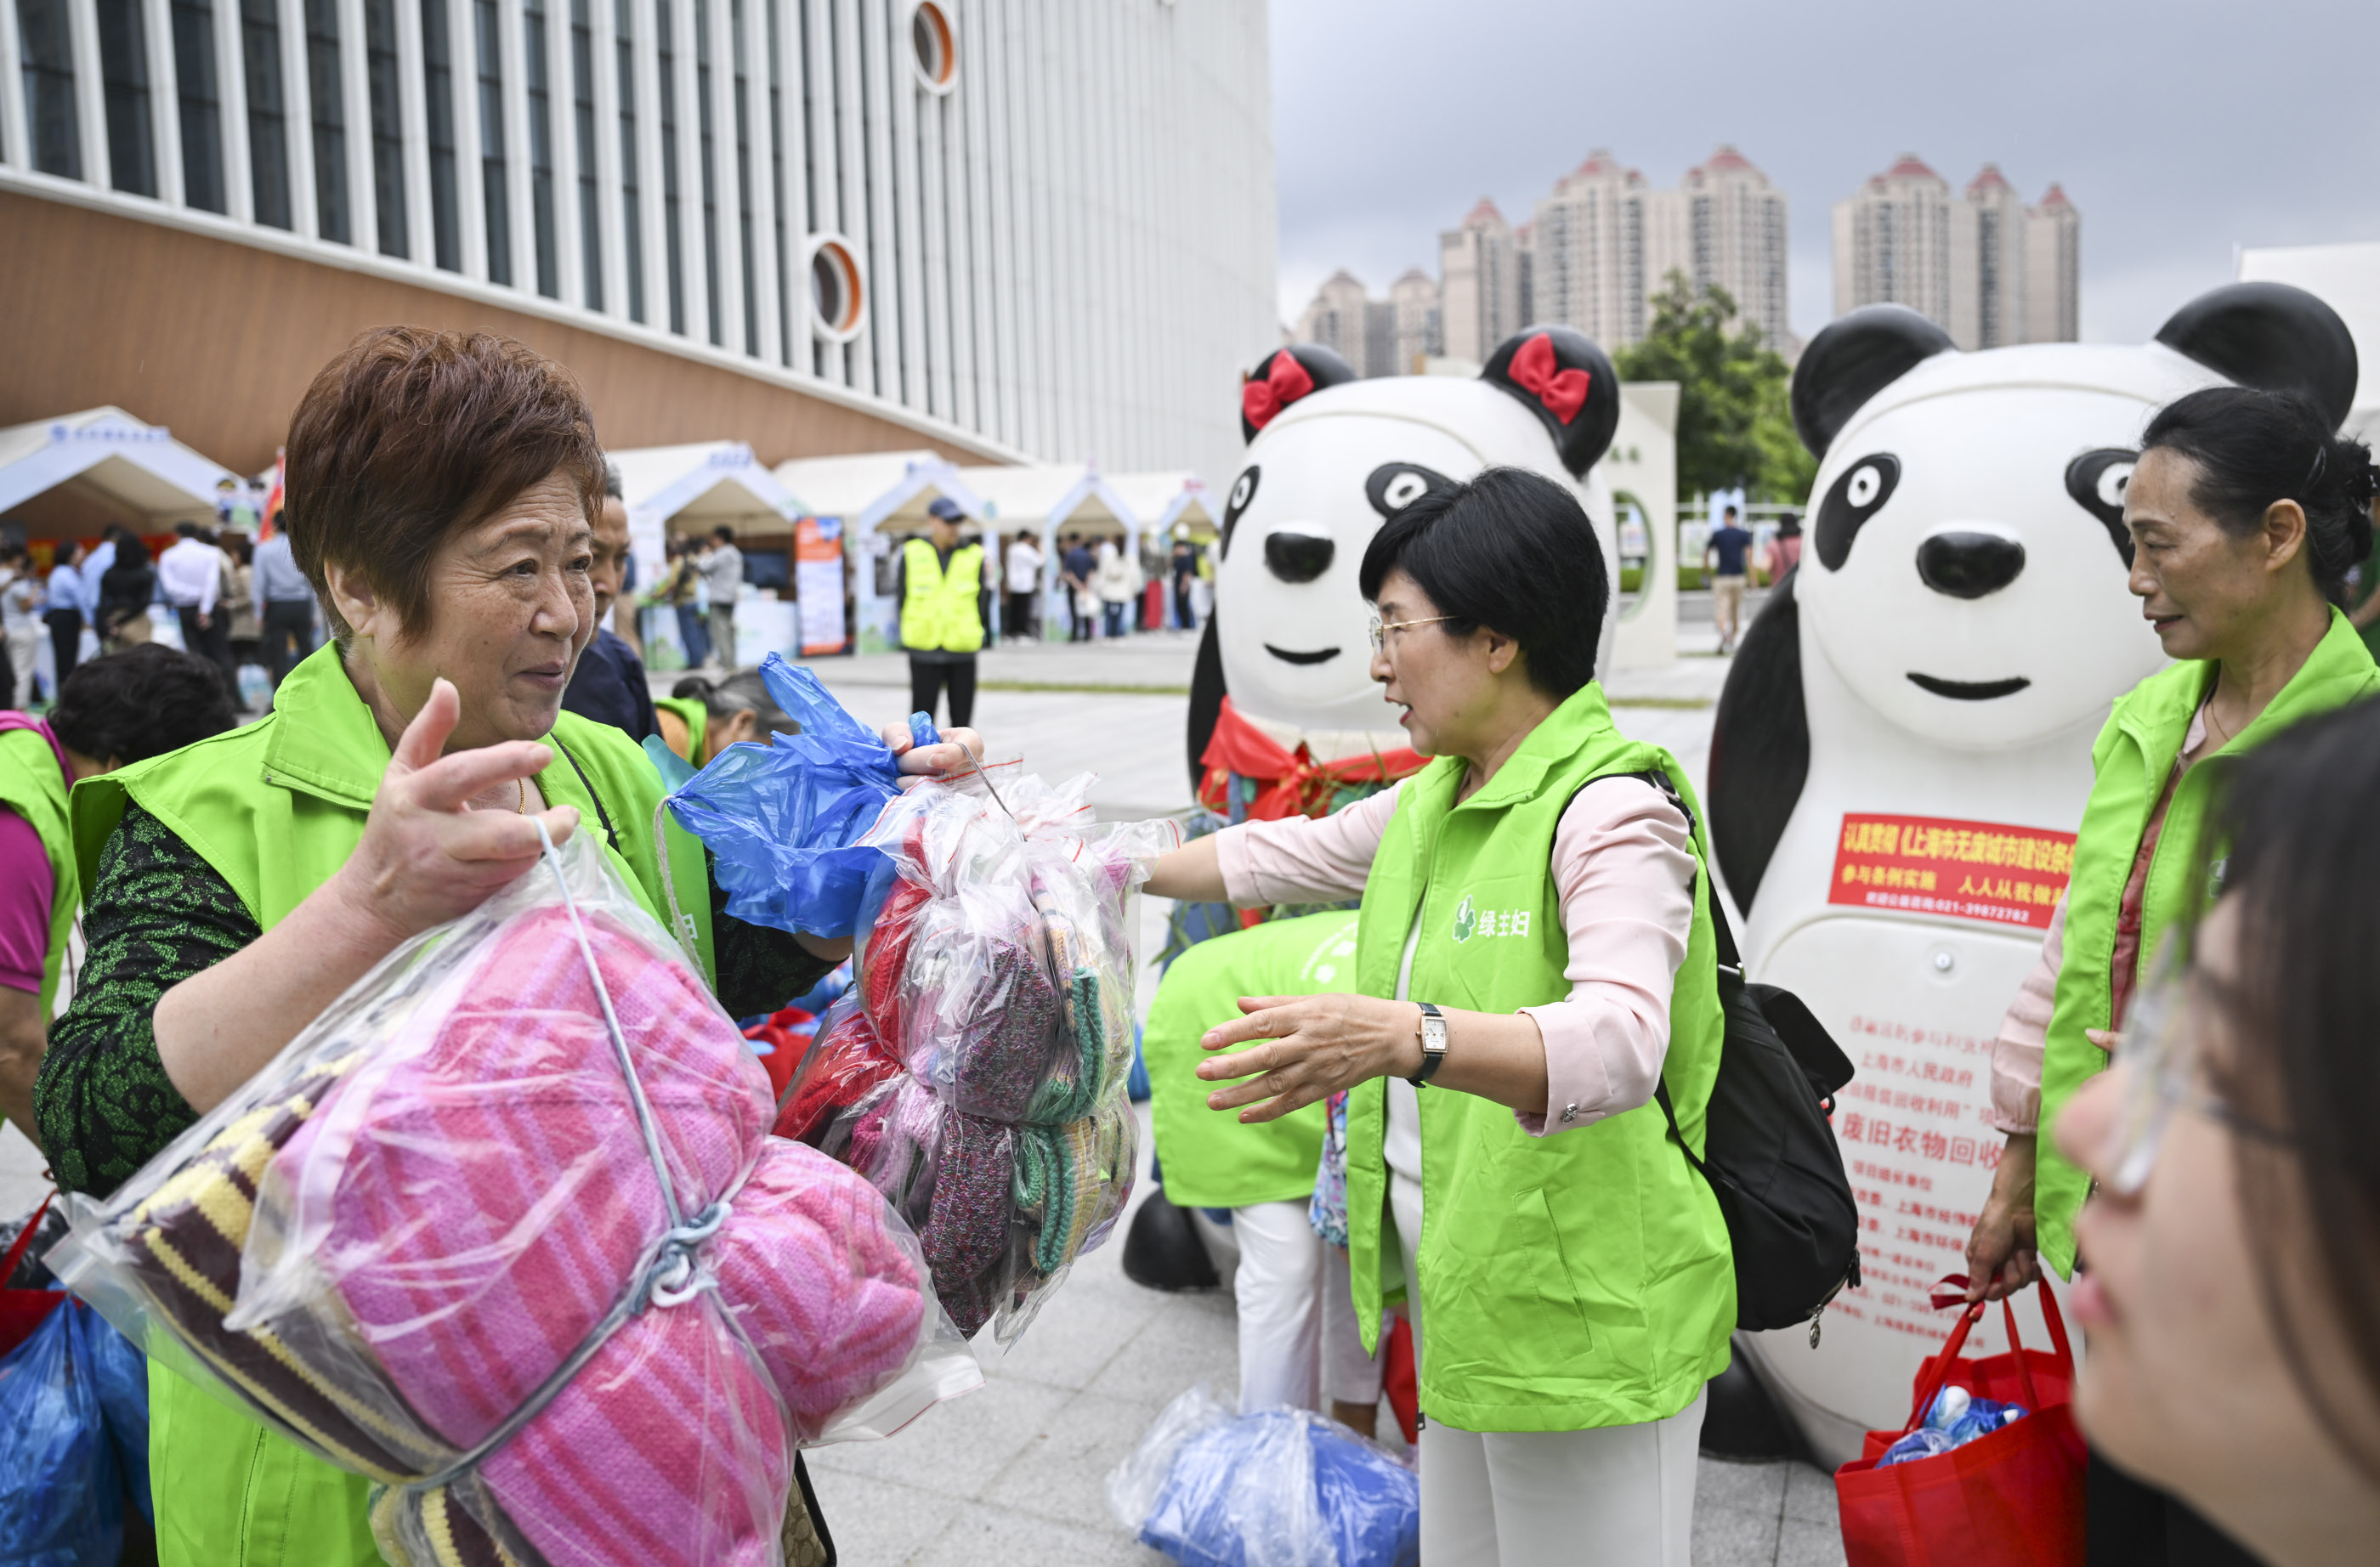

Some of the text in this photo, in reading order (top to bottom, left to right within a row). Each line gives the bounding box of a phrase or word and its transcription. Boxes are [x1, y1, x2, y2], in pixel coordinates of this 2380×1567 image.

[1841, 863, 1937, 891] 参与条例实施
[1477, 908, 1531, 938] 绿主妇
[1861, 1053, 1974, 1089] 上海市人民政府
[1841, 1112, 2004, 1171] 废旧衣物回收
